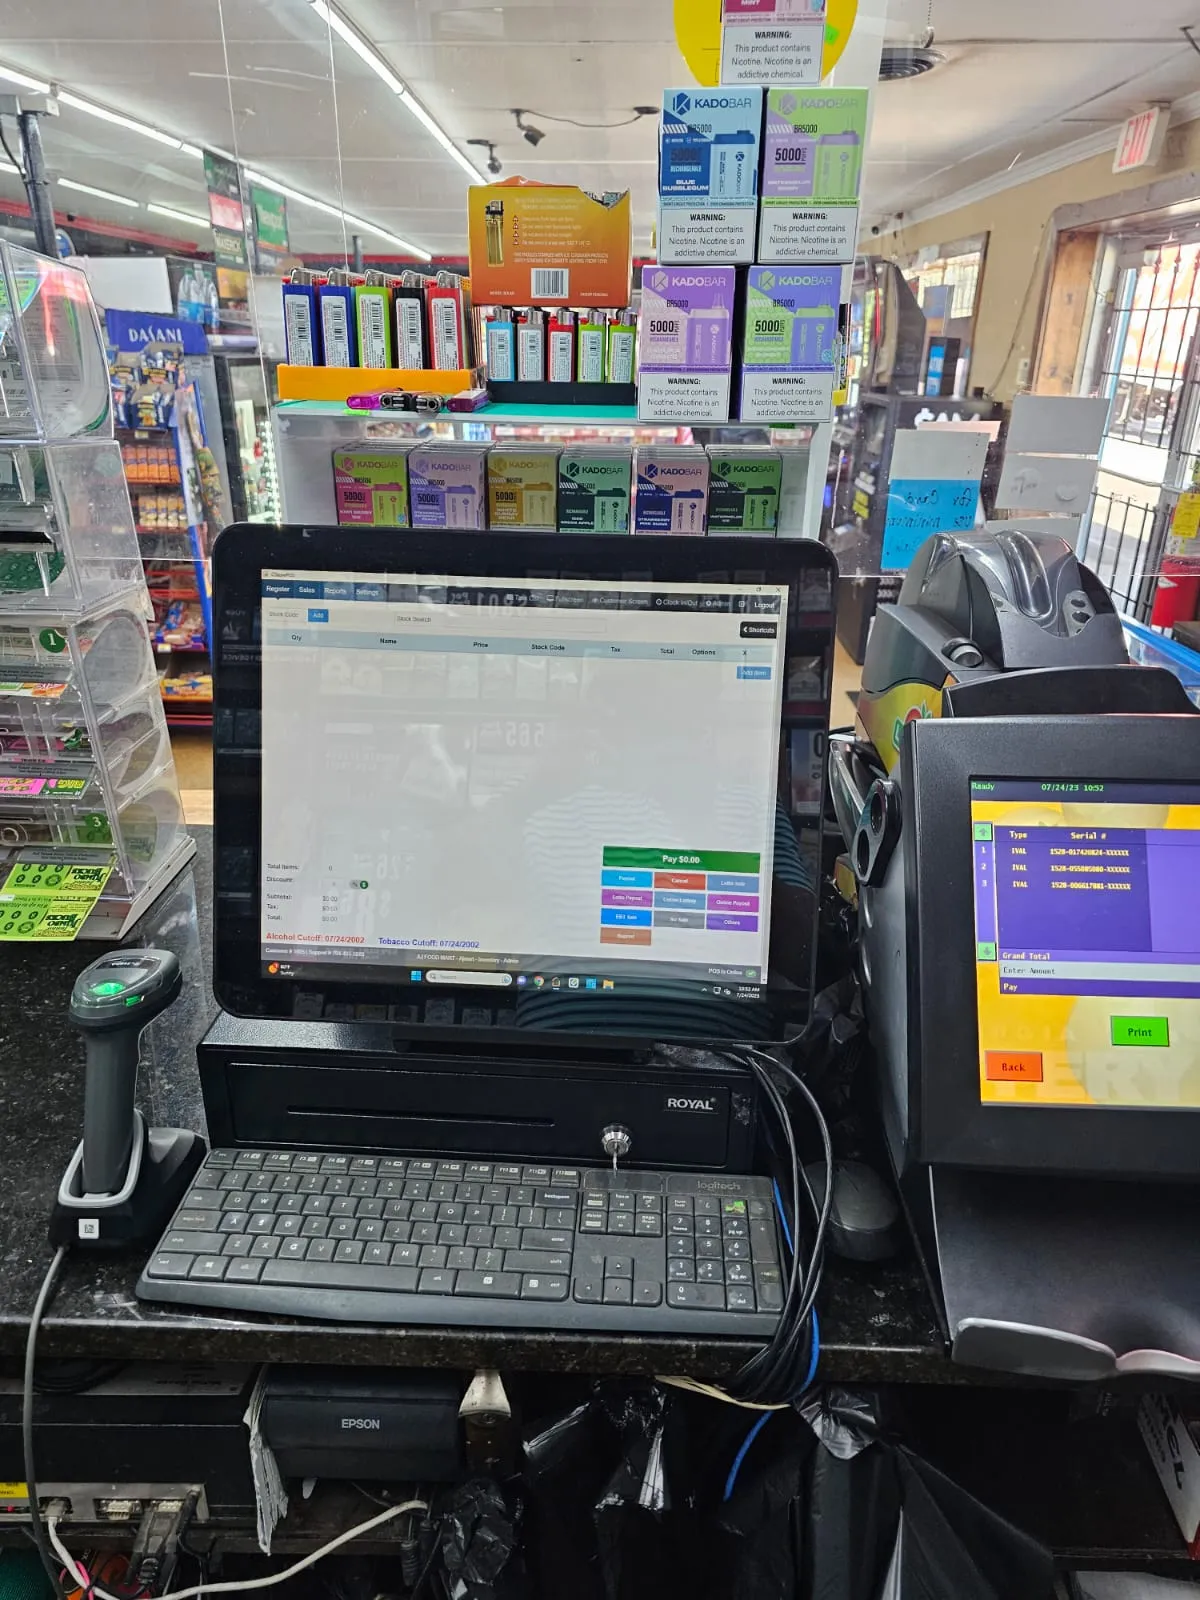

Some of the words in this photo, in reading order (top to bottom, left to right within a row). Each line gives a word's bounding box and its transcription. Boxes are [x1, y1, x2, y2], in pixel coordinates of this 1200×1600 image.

[755, 31, 792, 39] WARNING:
[736, 44, 749, 52] This
[752, 44, 778, 53] product
[781, 44, 811, 52] contains
[732, 57, 762, 66] Nicotine.
[764, 57, 793, 65] Nicotine
[796, 57, 801, 65] is
[738, 70, 769, 79] addictive
[695, 98, 752, 108] KADOBAR
[801, 98, 858, 109] KADOBAR
[794, 124, 818, 133] BR5000
[775, 148, 801, 161] 5000
[792, 212, 827, 220] WARNING:
[687, 226, 713, 235] product
[788, 225, 814, 234] product
[816, 225, 846, 233] contains
[669, 238, 697, 246] Nicotine.
[672, 277, 726, 287] KADOBAR
[779, 276, 833, 286] KADOBAR
[667, 300, 689, 308] BR5000
[650, 320, 674, 332] 5000
[755, 320, 779, 332] 5000
[128, 326, 184, 342] DASANI
[665, 388, 689, 396] product
[691, 388, 718, 396] contains
[770, 388, 793, 396] product
[357, 461, 398, 469] KADOBAR
[432, 464, 472, 472] KADOBAR
[508, 461, 549, 469] KADOBAR
[734, 465, 775, 473] KADOBAR
[660, 468, 702, 476] KADOBAR
[344, 492, 362, 501] 5000
[496, 492, 514, 501] 5000
[266, 585, 290, 594] Register
[299, 586, 316, 594] Sales
[324, 587, 347, 596] Reports
[356, 588, 379, 597] Settings
[754, 602, 776, 610] Logout
[48, 634, 57, 646] 1
[972, 782, 995, 791] Ready
[1042, 784, 1079, 792] 07/24/23
[1084, 784, 1104, 792] 10:52
[92, 816, 102, 827] 3
[1009, 831, 1028, 840] Type
[1070, 832, 1097, 840] Serial
[662, 855, 677, 864] Pay
[679, 856, 700, 864] $0.00
[266, 933, 296, 941] Alcohol
[297, 934, 324, 942] Cutoff:
[325, 935, 365, 944] 07/24/2002
[379, 938, 411, 946] Tobacco
[413, 939, 438, 947] Cutoff:
[440, 940, 480, 949] 07/24/2002
[1003, 952, 1026, 960] Grand
[1004, 983, 1018, 992] Pay
[1128, 1028, 1152, 1038] Print
[1002, 1063, 1026, 1072] Back
[668, 1098, 713, 1110] ROYAL
[698, 1181, 741, 1191] logitech
[342, 1419, 380, 1430] EPSON
